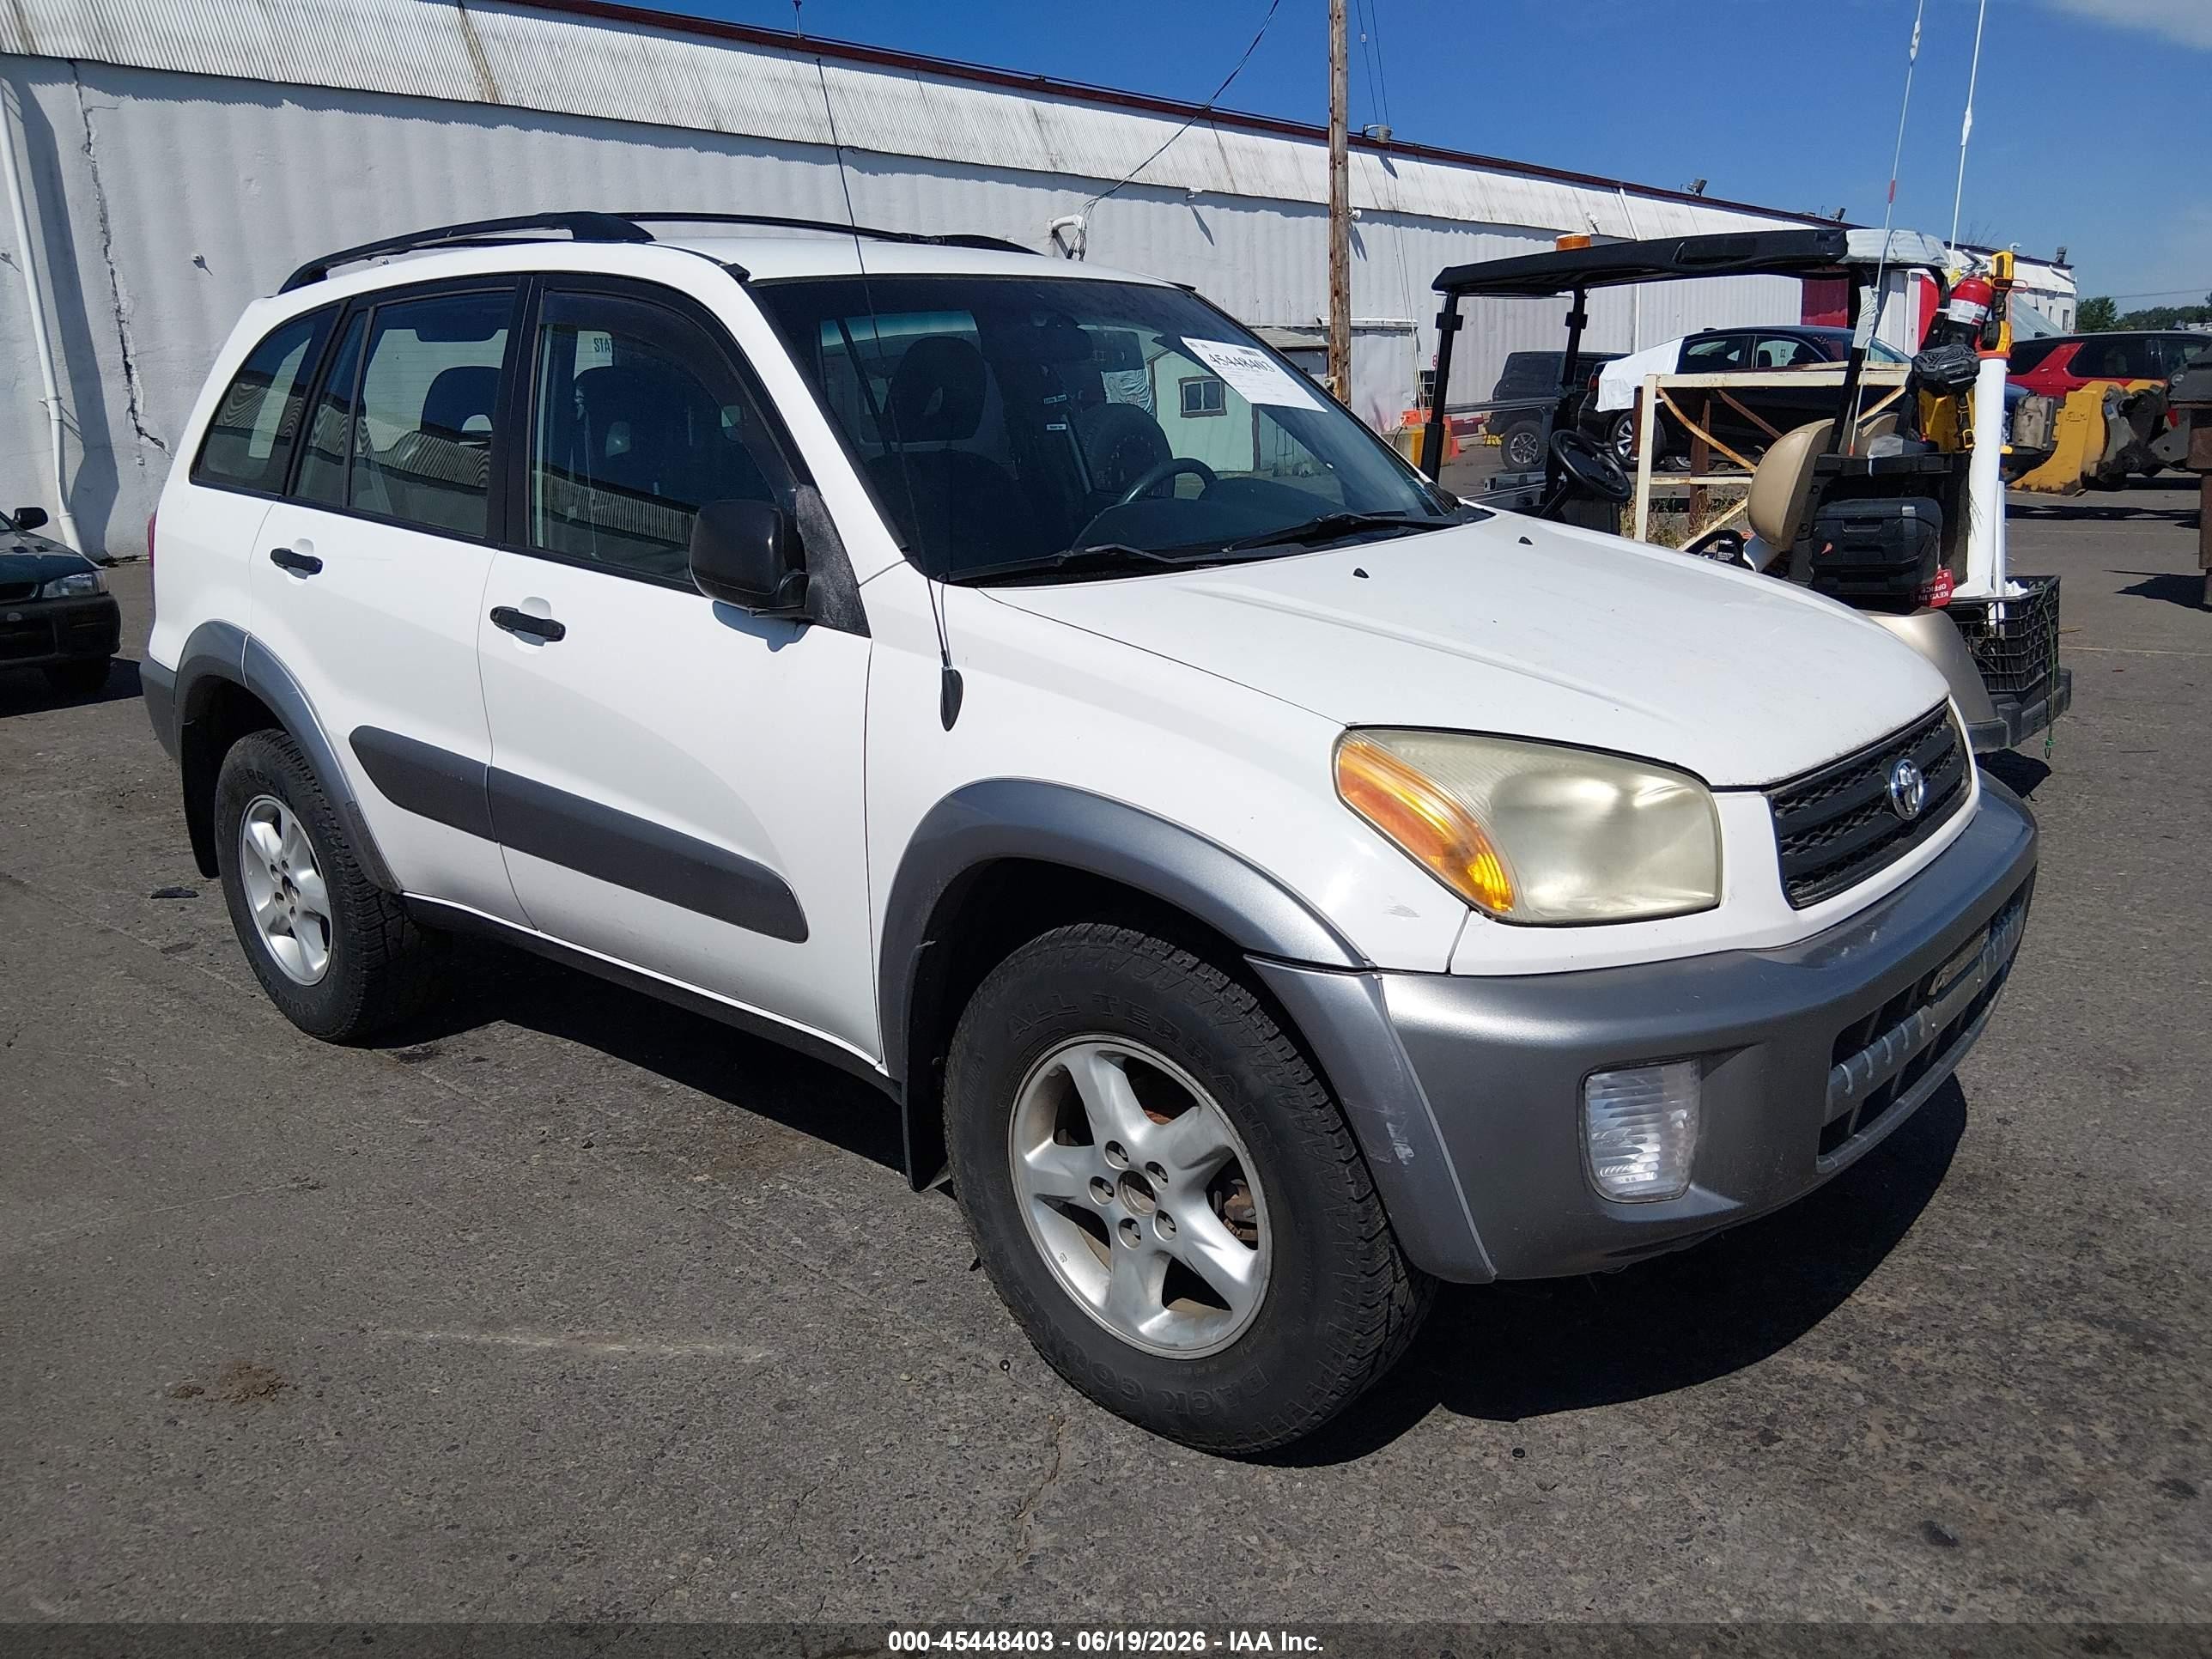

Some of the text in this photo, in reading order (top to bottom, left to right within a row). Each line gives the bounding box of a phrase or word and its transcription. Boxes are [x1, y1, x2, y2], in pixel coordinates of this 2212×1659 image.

[593, 336, 612, 353] STA
[1208, 353, 1276, 373] 45448403
[1007, 992, 1080, 1042] ALL
[1091, 992, 1280, 1164] TERRAIN
